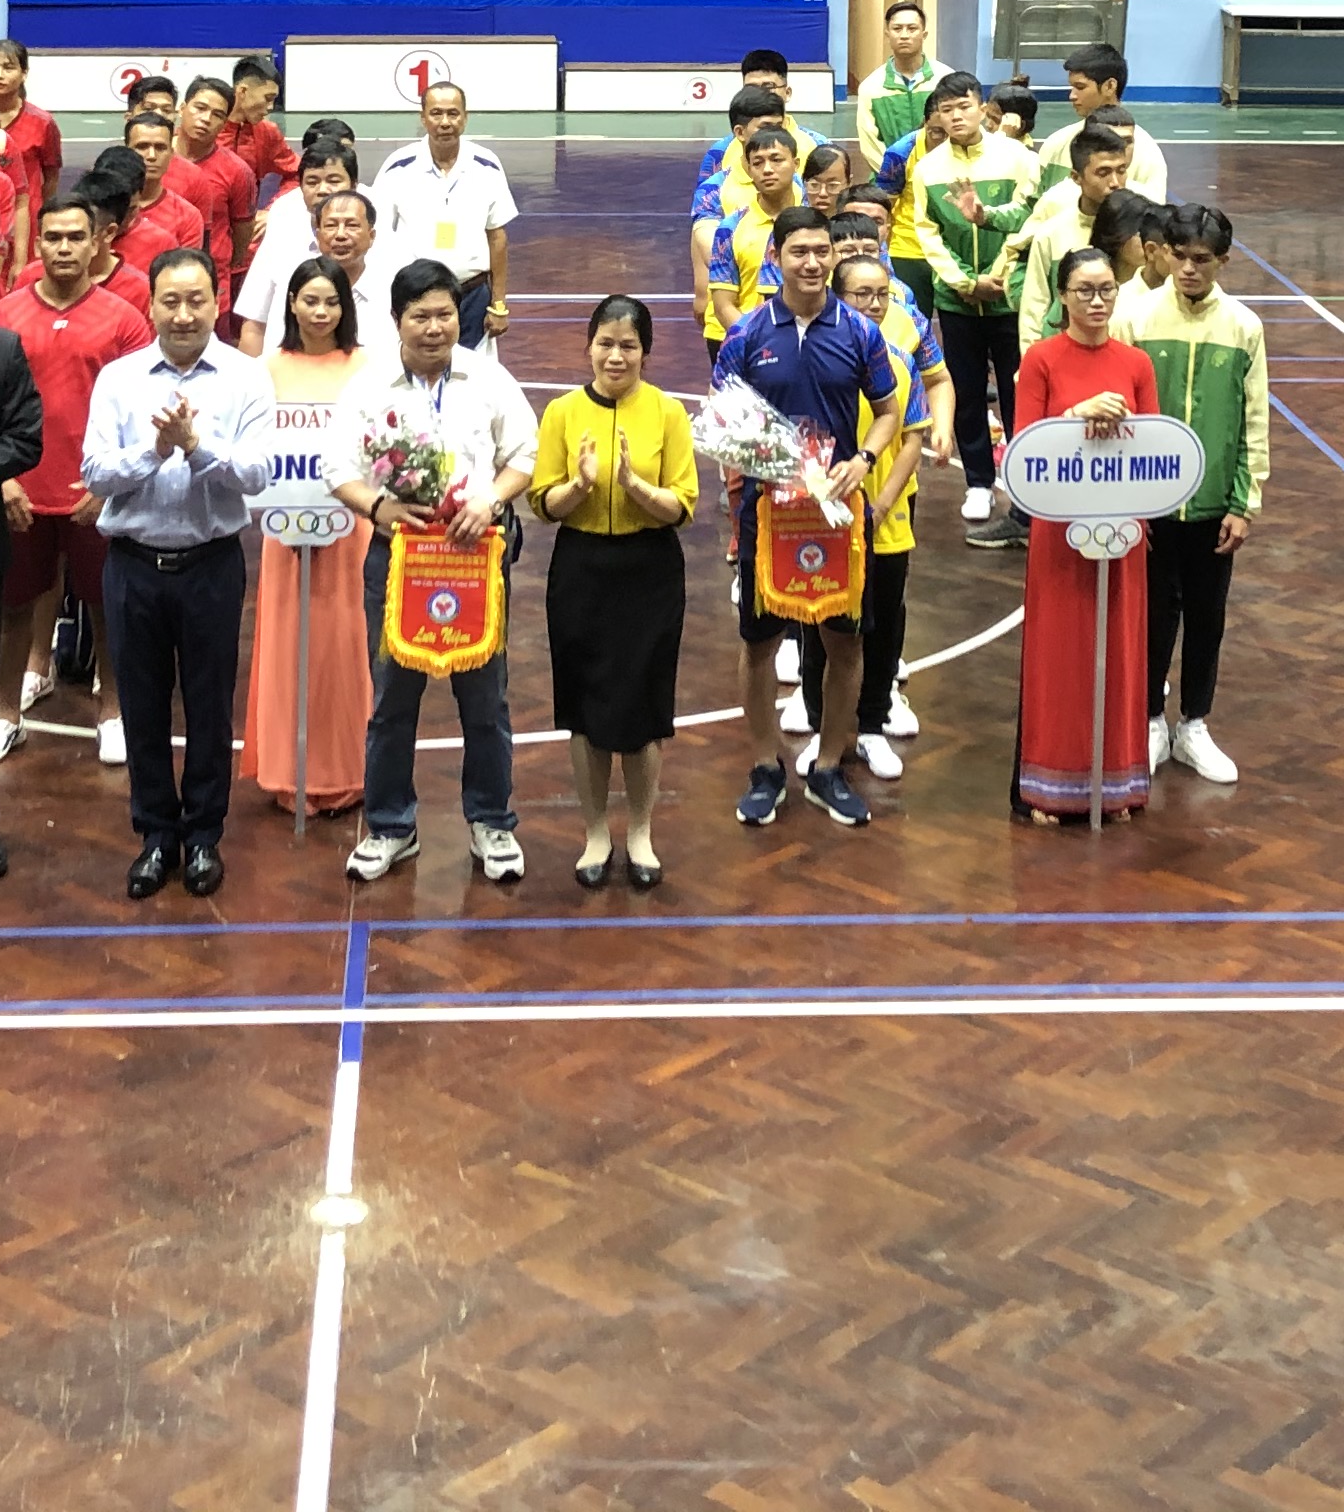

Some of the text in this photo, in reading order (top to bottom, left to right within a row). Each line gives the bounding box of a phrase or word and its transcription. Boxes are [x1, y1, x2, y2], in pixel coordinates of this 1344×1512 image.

[120, 68, 143, 95] 2
[408, 60, 429, 97] 1
[692, 81, 707, 99] 3
[1024, 447, 1180, 483] TP. HỒ CHÍ MINH
